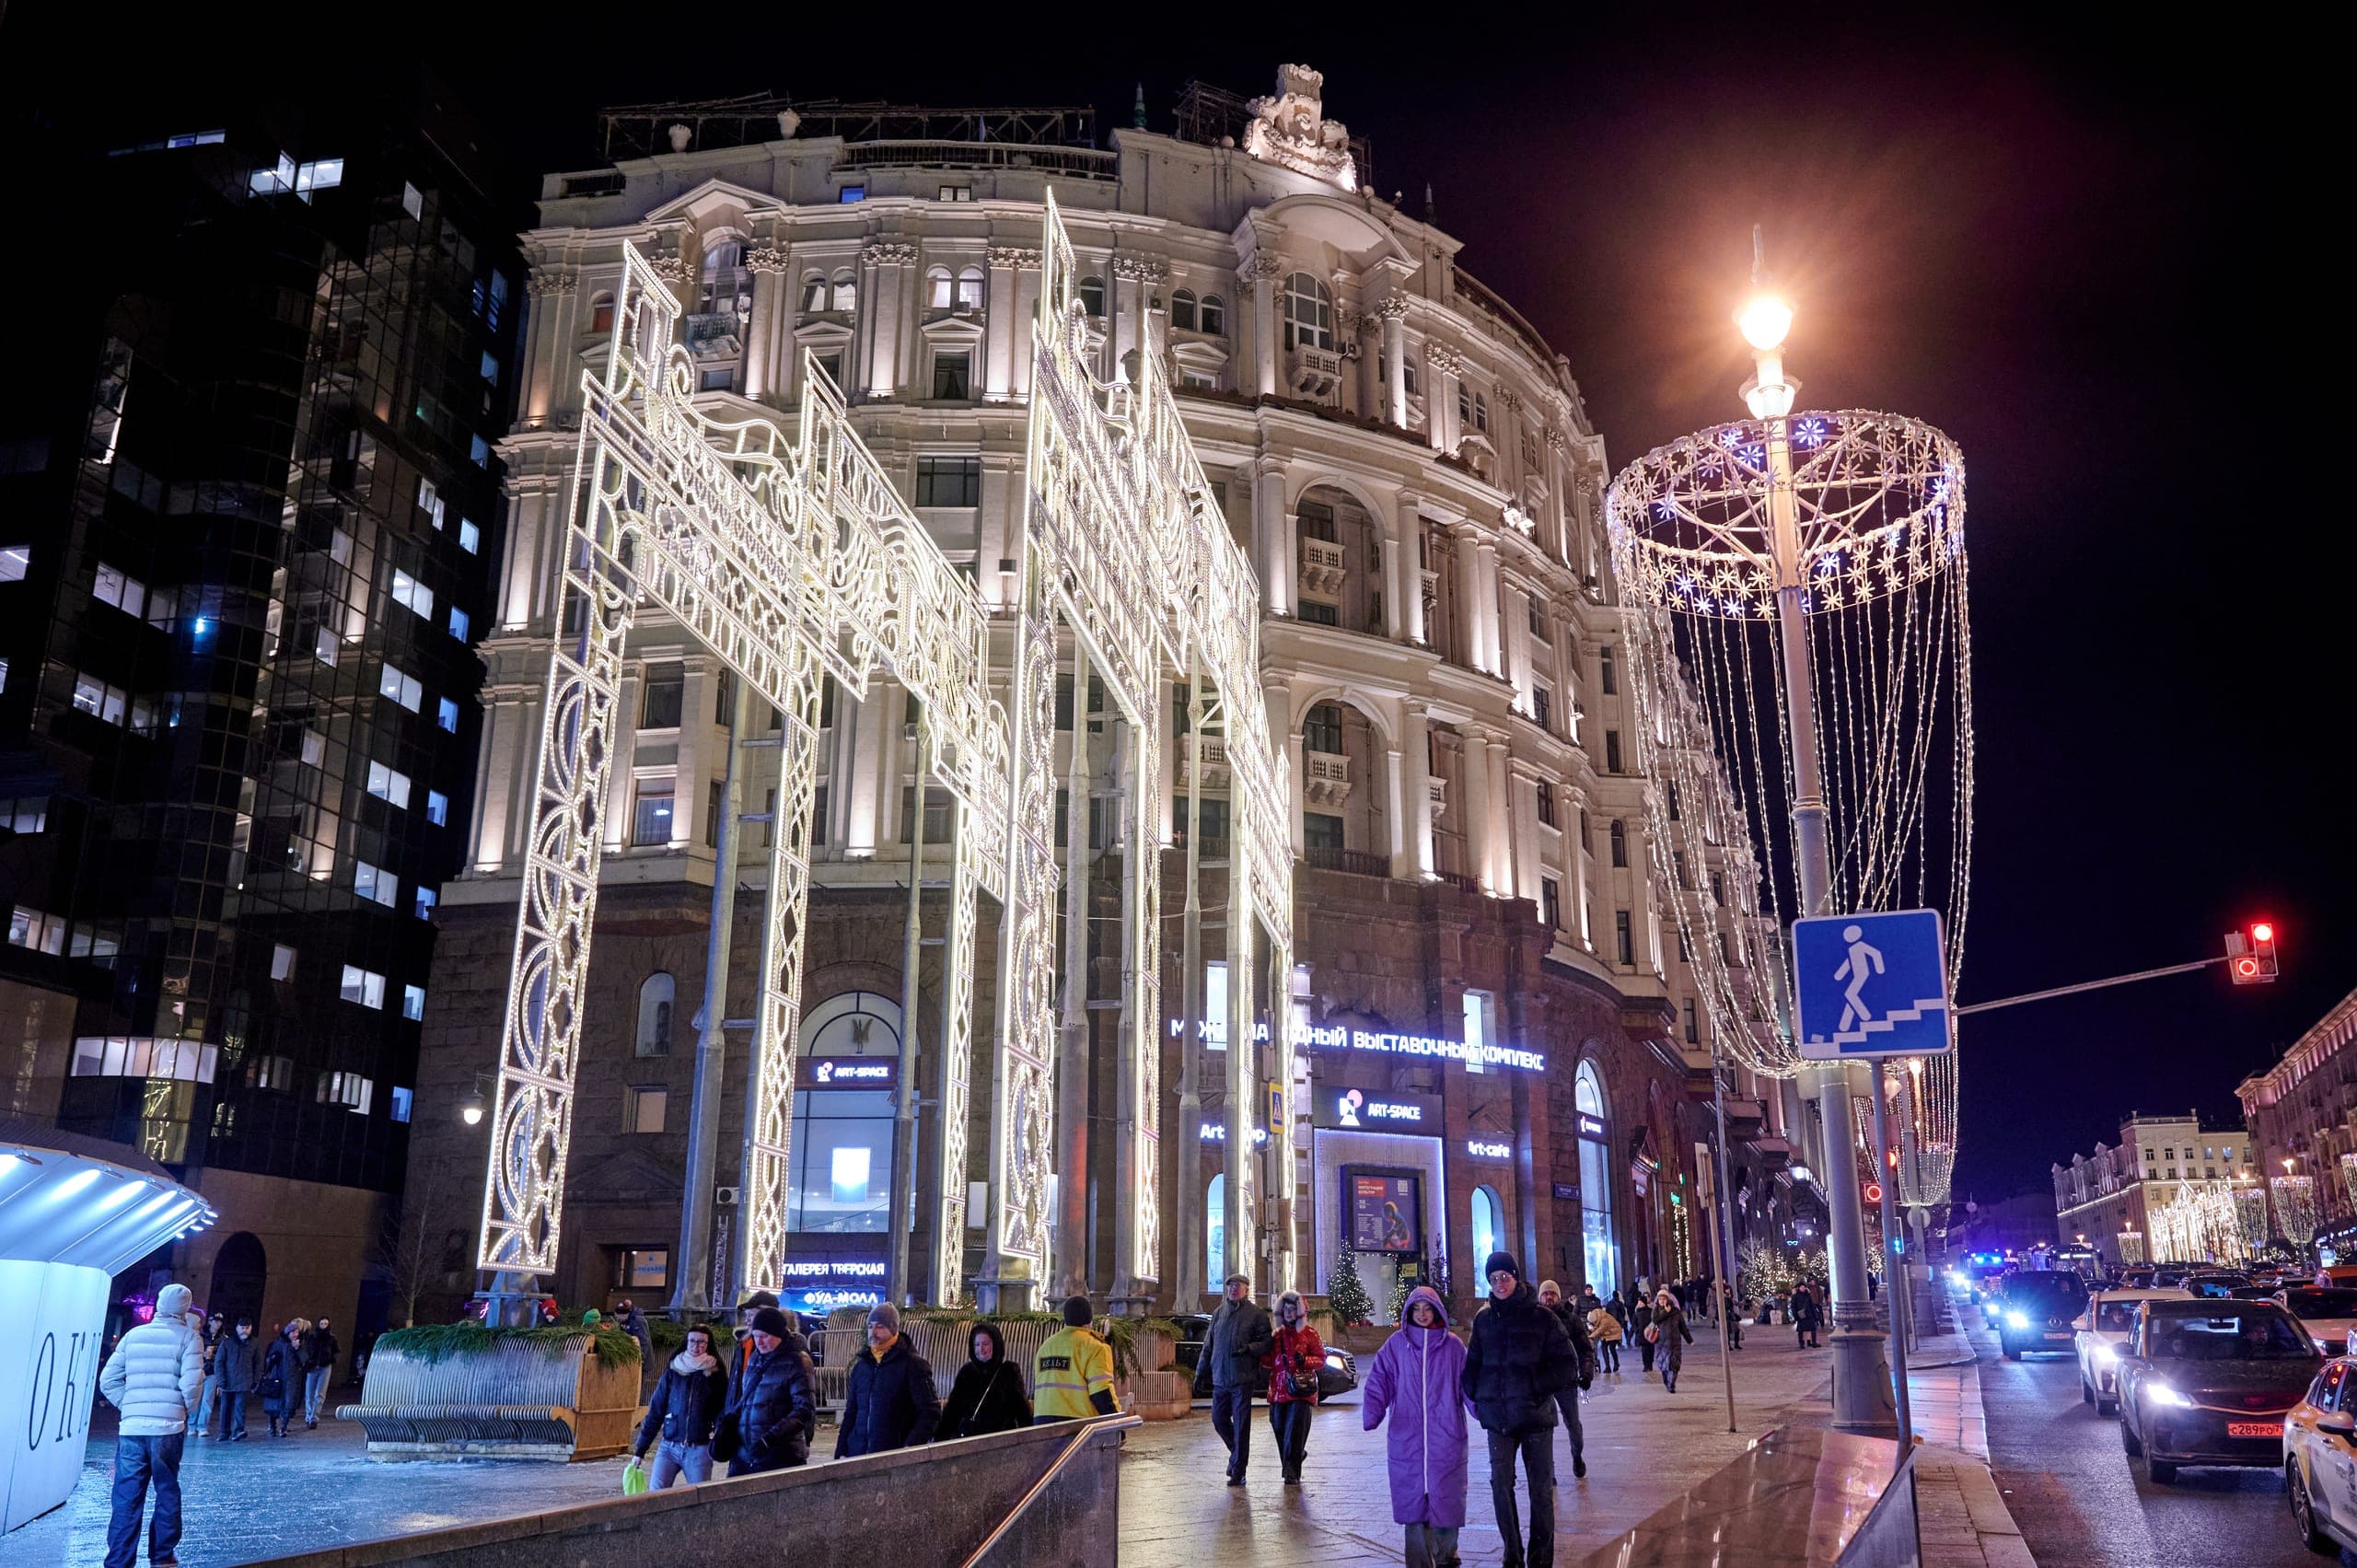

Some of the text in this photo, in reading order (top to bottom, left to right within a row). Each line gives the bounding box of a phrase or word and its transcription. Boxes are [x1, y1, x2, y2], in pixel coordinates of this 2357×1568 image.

[1353, 1031, 1477, 1062] ВЫСТАВОЧНЫЙ
[1480, 1045, 1545, 1071] КОМПЛЕКС
[835, 1066, 888, 1077] ART-SPACE
[1367, 1102, 1422, 1121] ART-SPACE
[783, 1262, 885, 1276] ГАЛЕРЕЯ ТВЕРСКАЯ
